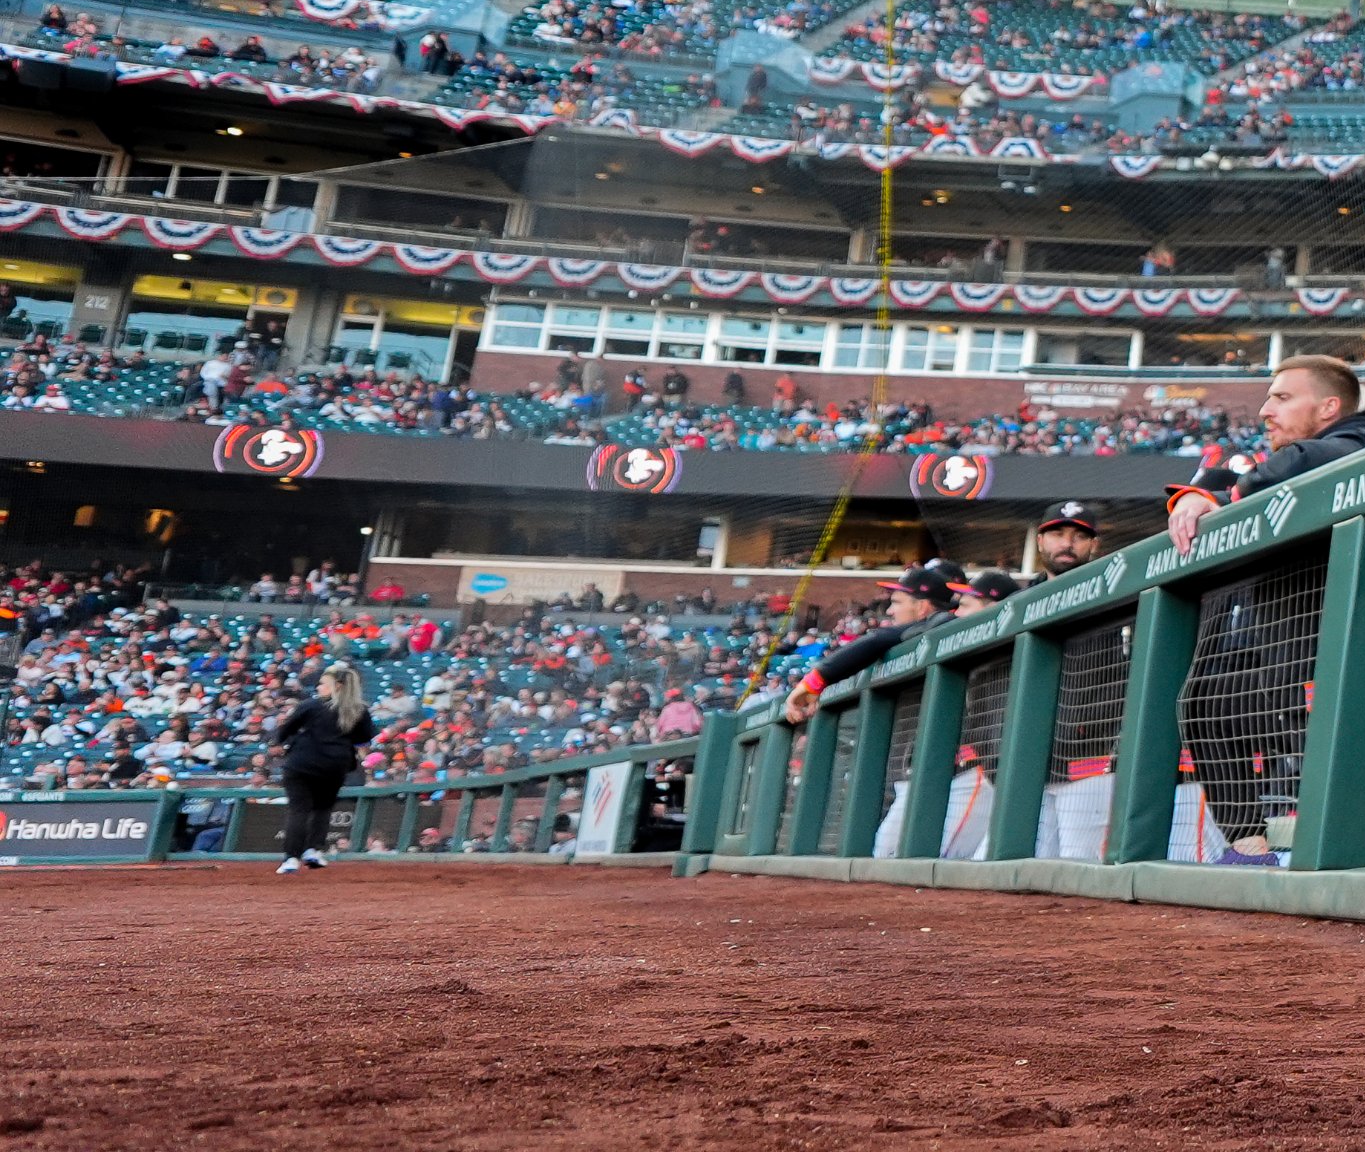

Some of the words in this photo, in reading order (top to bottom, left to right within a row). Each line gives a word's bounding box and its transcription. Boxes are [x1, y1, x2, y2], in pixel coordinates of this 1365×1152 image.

[1145, 546, 1179, 580] BANK
[1196, 514, 1262, 562] AMERICA
[1023, 595, 1049, 625] BANK
[1046, 591, 1063, 616] OF
[1058, 575, 1104, 610] AMERICA
[6, 818, 100, 839] Hanwha
[102, 817, 148, 839] Life
